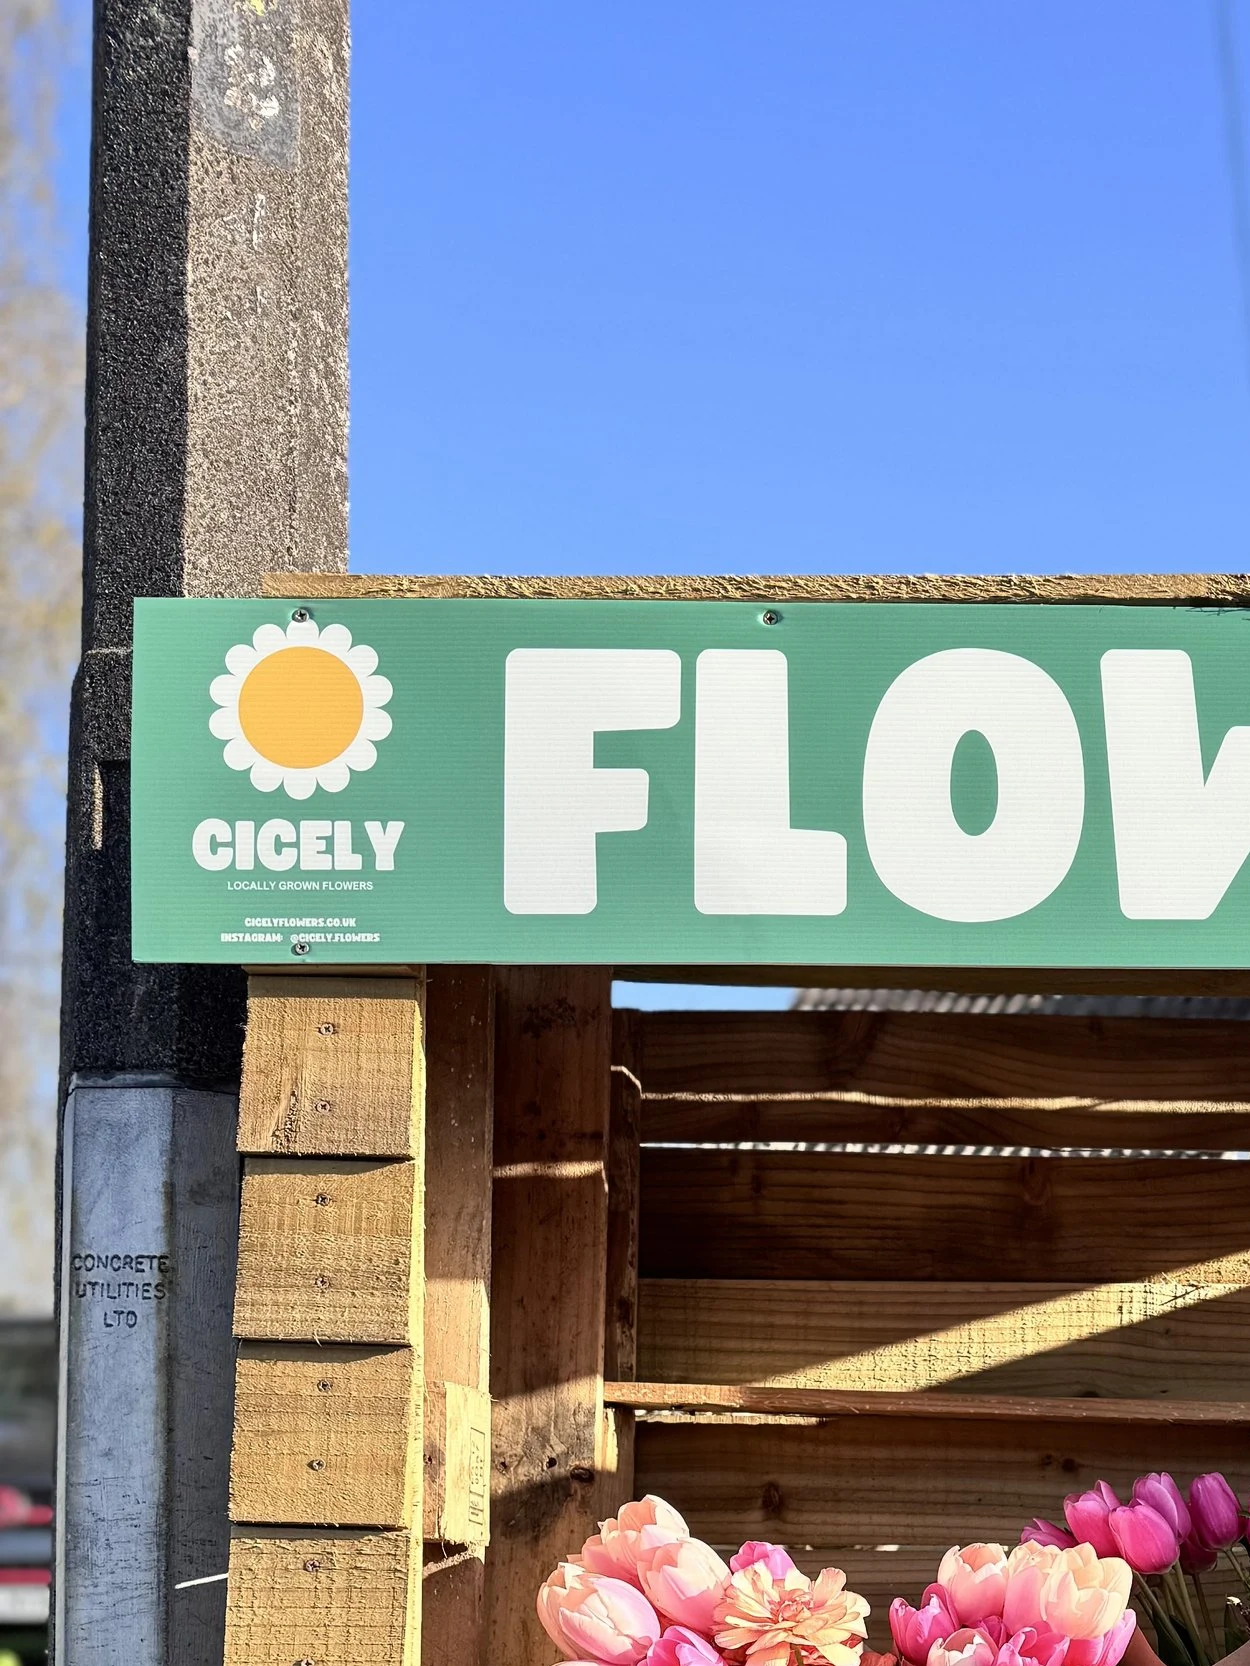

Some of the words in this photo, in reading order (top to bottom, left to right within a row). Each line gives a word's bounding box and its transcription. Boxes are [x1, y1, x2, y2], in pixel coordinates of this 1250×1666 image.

[191, 818, 405, 872] CICELY
[227, 881, 276, 891] LOCALLY
[278, 881, 320, 891] GROWN
[322, 881, 374, 891] FLOWERS
[244, 917, 357, 928] CICELYFLOWERS.CO.UK
[71, 1253, 170, 1273] CONCRETE
[75, 1281, 166, 1300] UTILITIES
